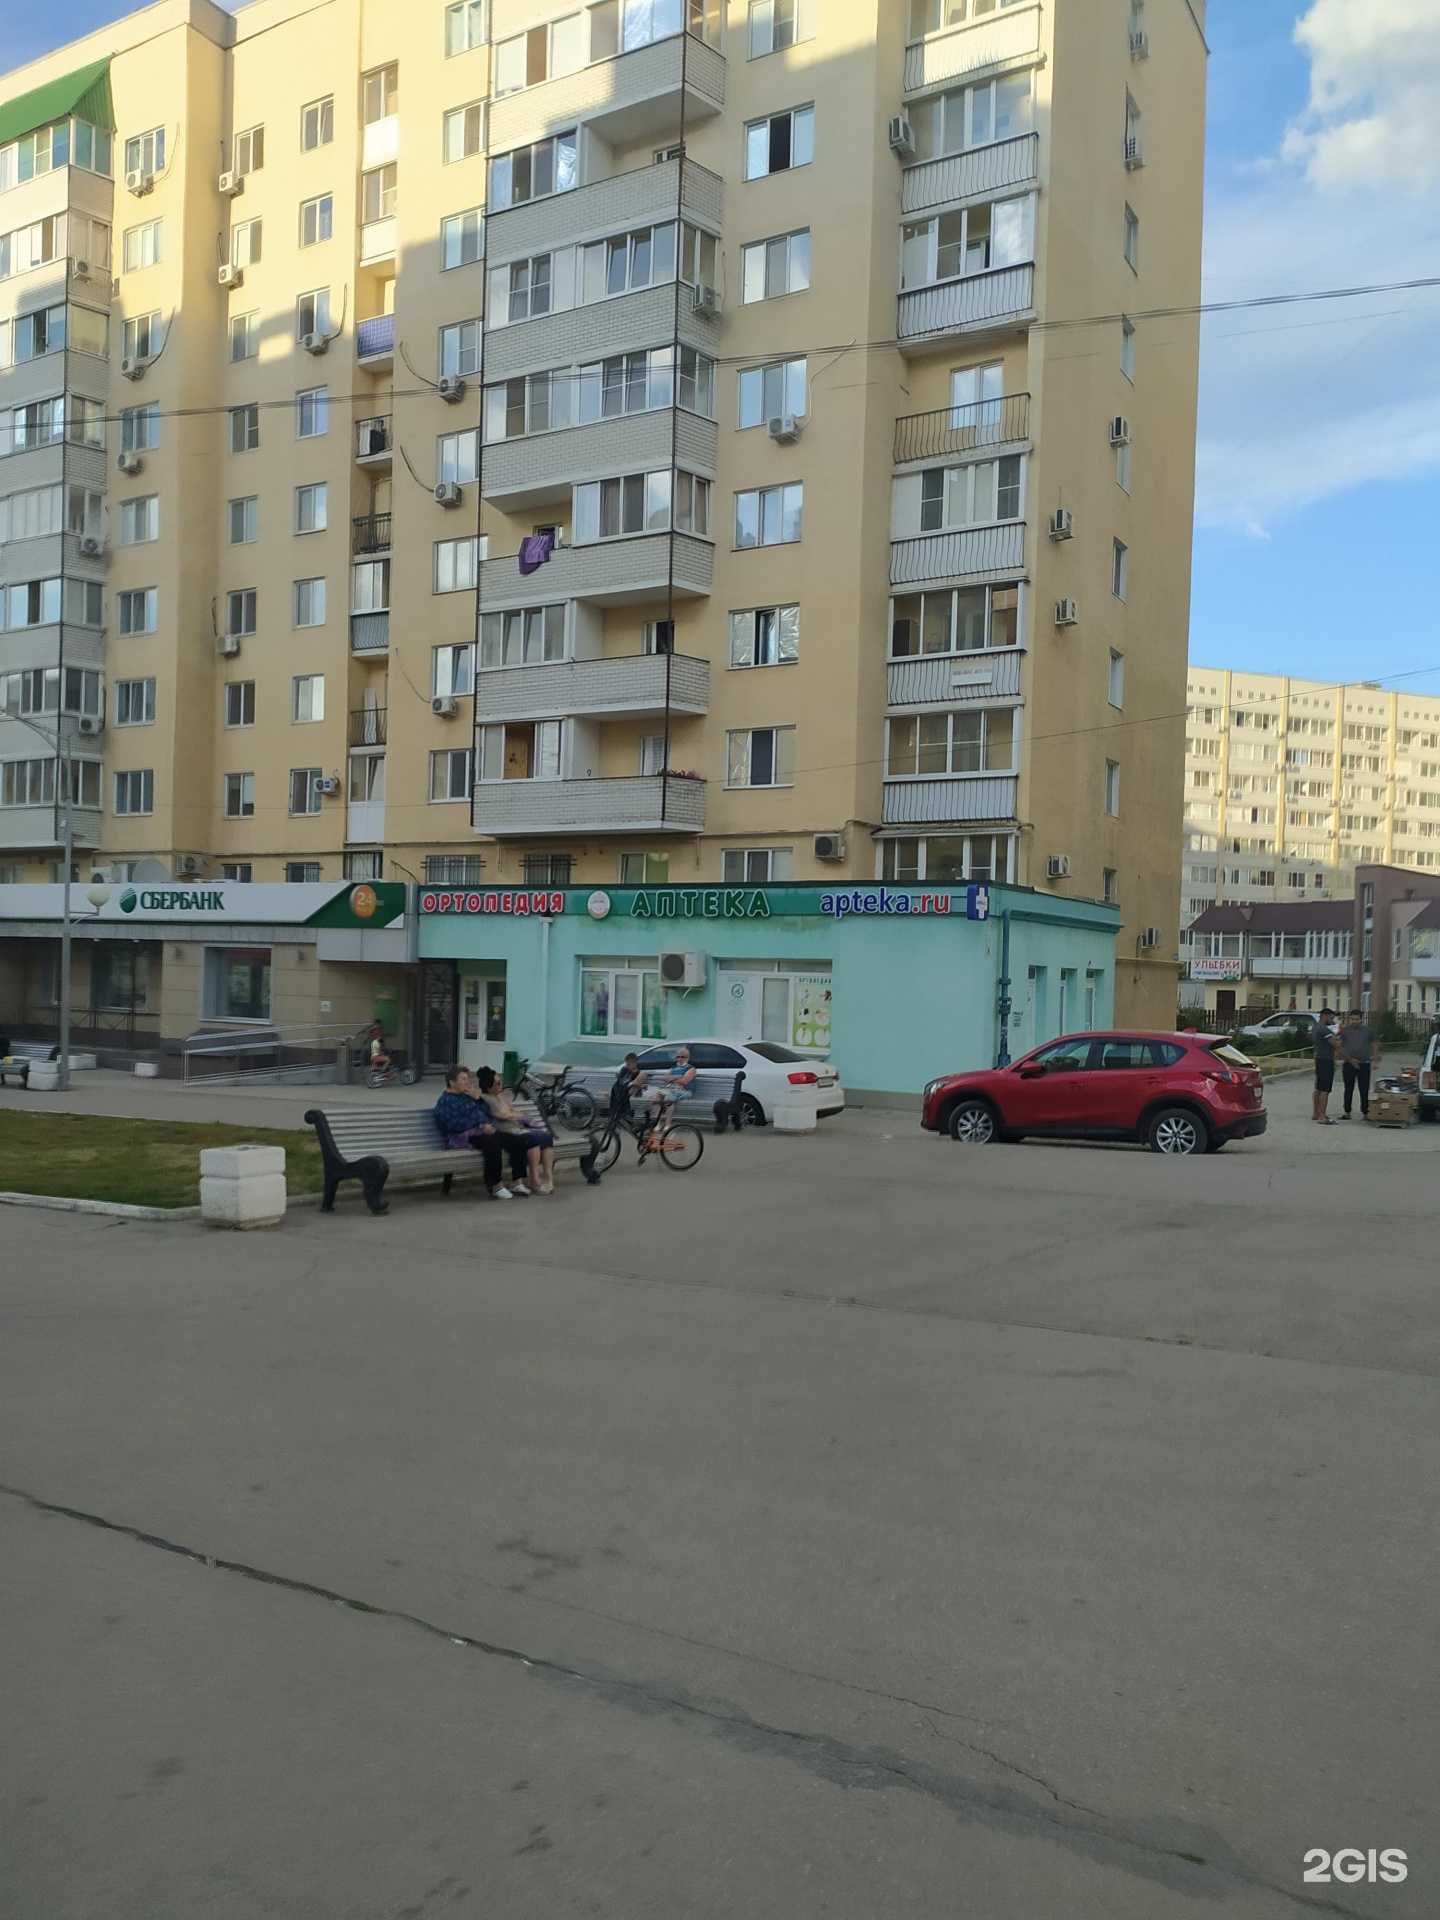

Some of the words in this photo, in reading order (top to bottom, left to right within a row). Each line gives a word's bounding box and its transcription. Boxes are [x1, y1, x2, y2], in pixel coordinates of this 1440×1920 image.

[140, 891, 225, 911] СБЕРБАНК
[422, 892, 564, 916] ОРТОПЕДИЯ
[630, 889, 771, 918] АПТЕКА
[821, 887, 951, 919] apteka.ru
[1194, 960, 1240, 969] УЛЫБКИ
